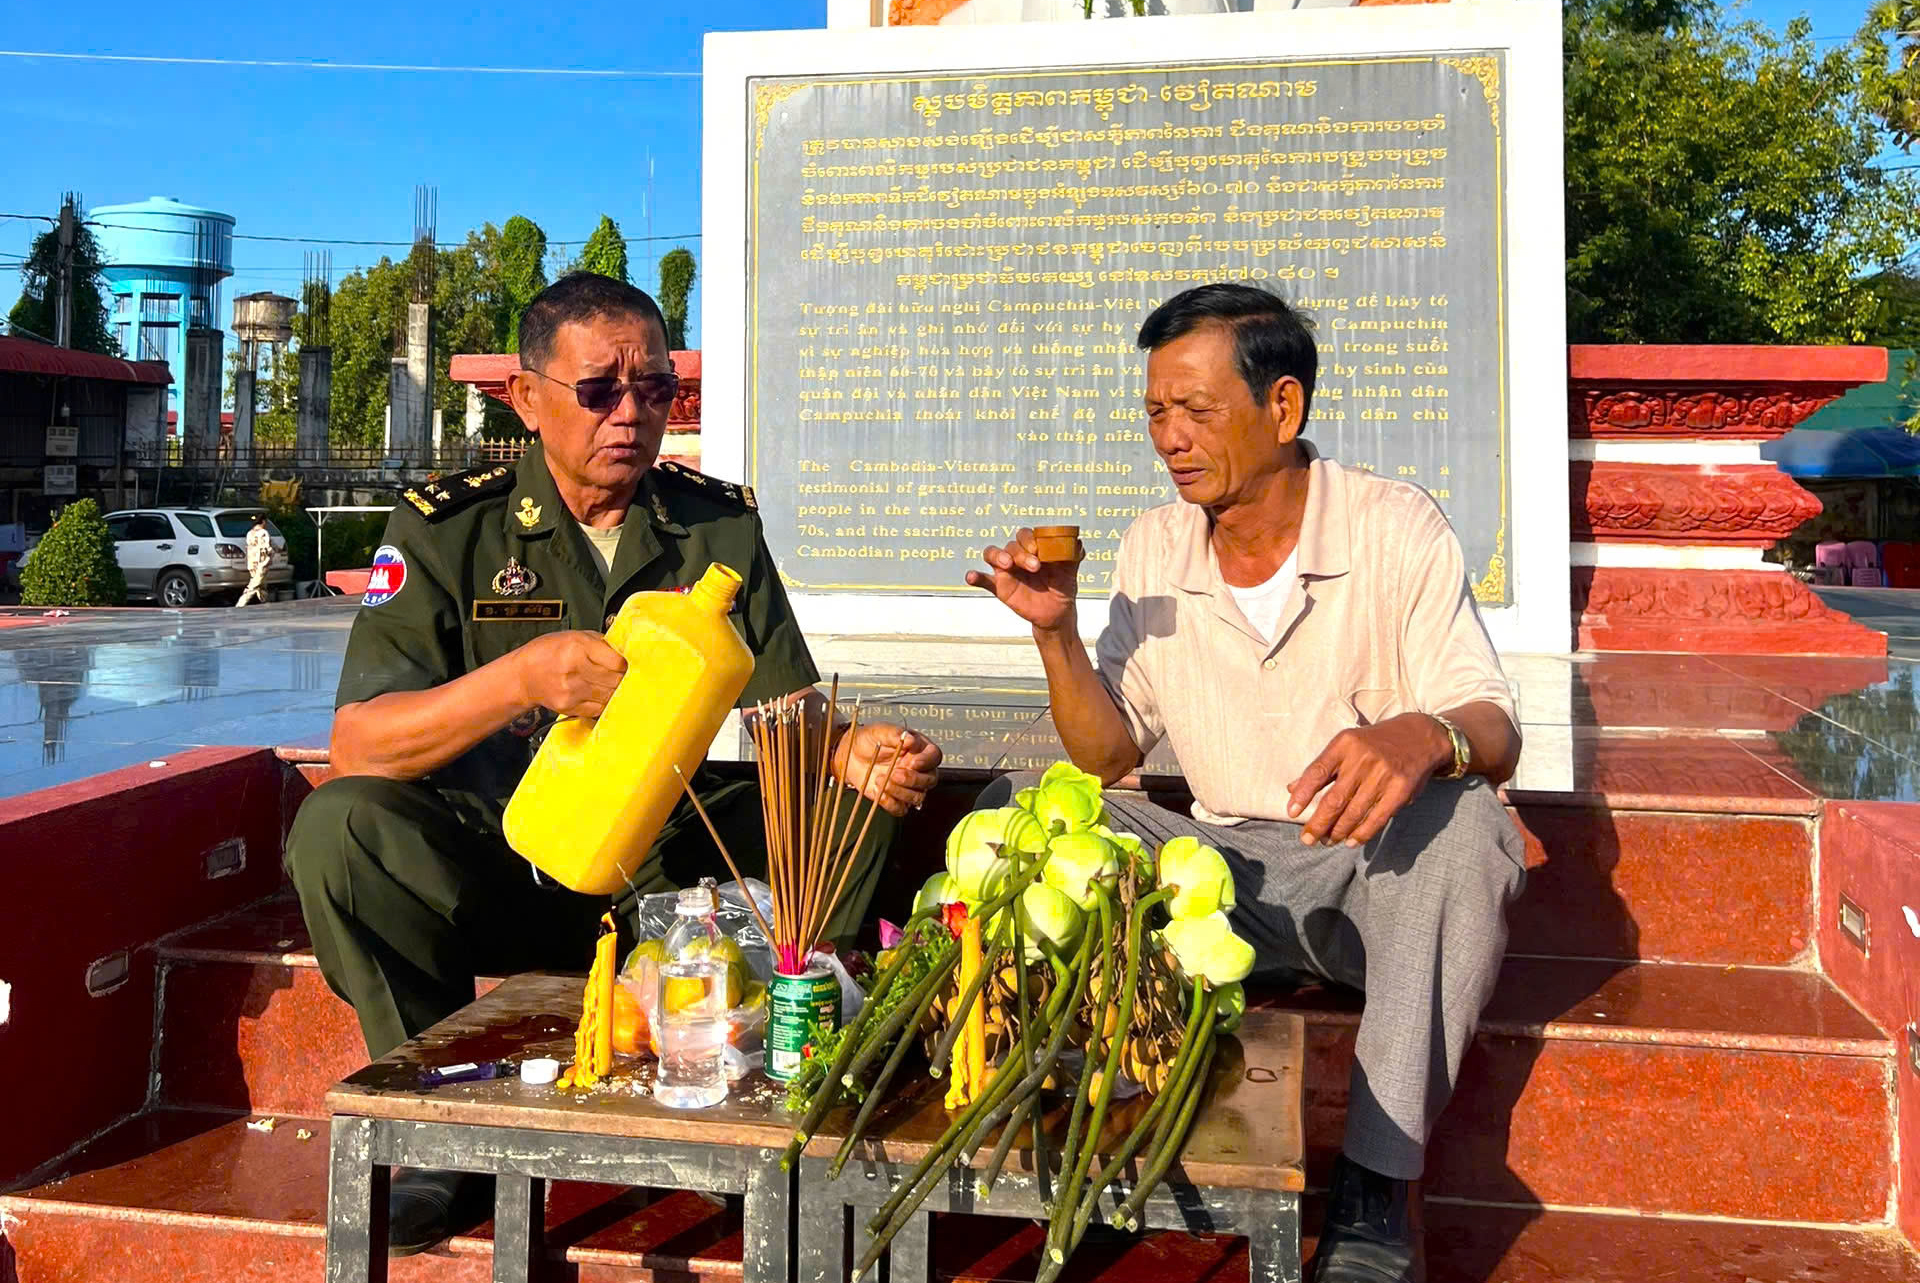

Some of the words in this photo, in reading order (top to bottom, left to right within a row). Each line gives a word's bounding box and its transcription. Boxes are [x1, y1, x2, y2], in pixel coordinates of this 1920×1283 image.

[916, 322, 944, 337] ghi
[1102, 321, 1125, 335] hy
[1331, 317, 1448, 332] Campuchia
[1344, 342, 1398, 355] trong
[1334, 363, 1358, 377] hy
[1056, 386, 1100, 398] Nam
[799, 408, 904, 423] Campuchia
[798, 459, 831, 472] The
[850, 459, 1016, 473] Cambodia-Vietnam
[1037, 460, 1132, 475] Friendship
[798, 482, 890, 494] testimonial
[896, 481, 914, 493] of
[918, 481, 996, 497] gratitude
[1003, 481, 1028, 494] for
[1033, 482, 1065, 494] and
[1072, 482, 1088, 494] in
[1095, 484, 1169, 497] memory
[798, 504, 852, 518] people
[860, 504, 876, 515] in
[885, 504, 911, 515] the
[920, 505, 966, 515] cause
[975, 504, 992, 515] of
[1001, 504, 1087, 517] Vietnam's
[835, 525, 866, 537] and
[872, 525, 899, 537] the
[904, 525, 974, 537] sacrifice
[980, 525, 998, 537] of
[797, 545, 894, 558] Cambodian
[900, 545, 955, 561] people
